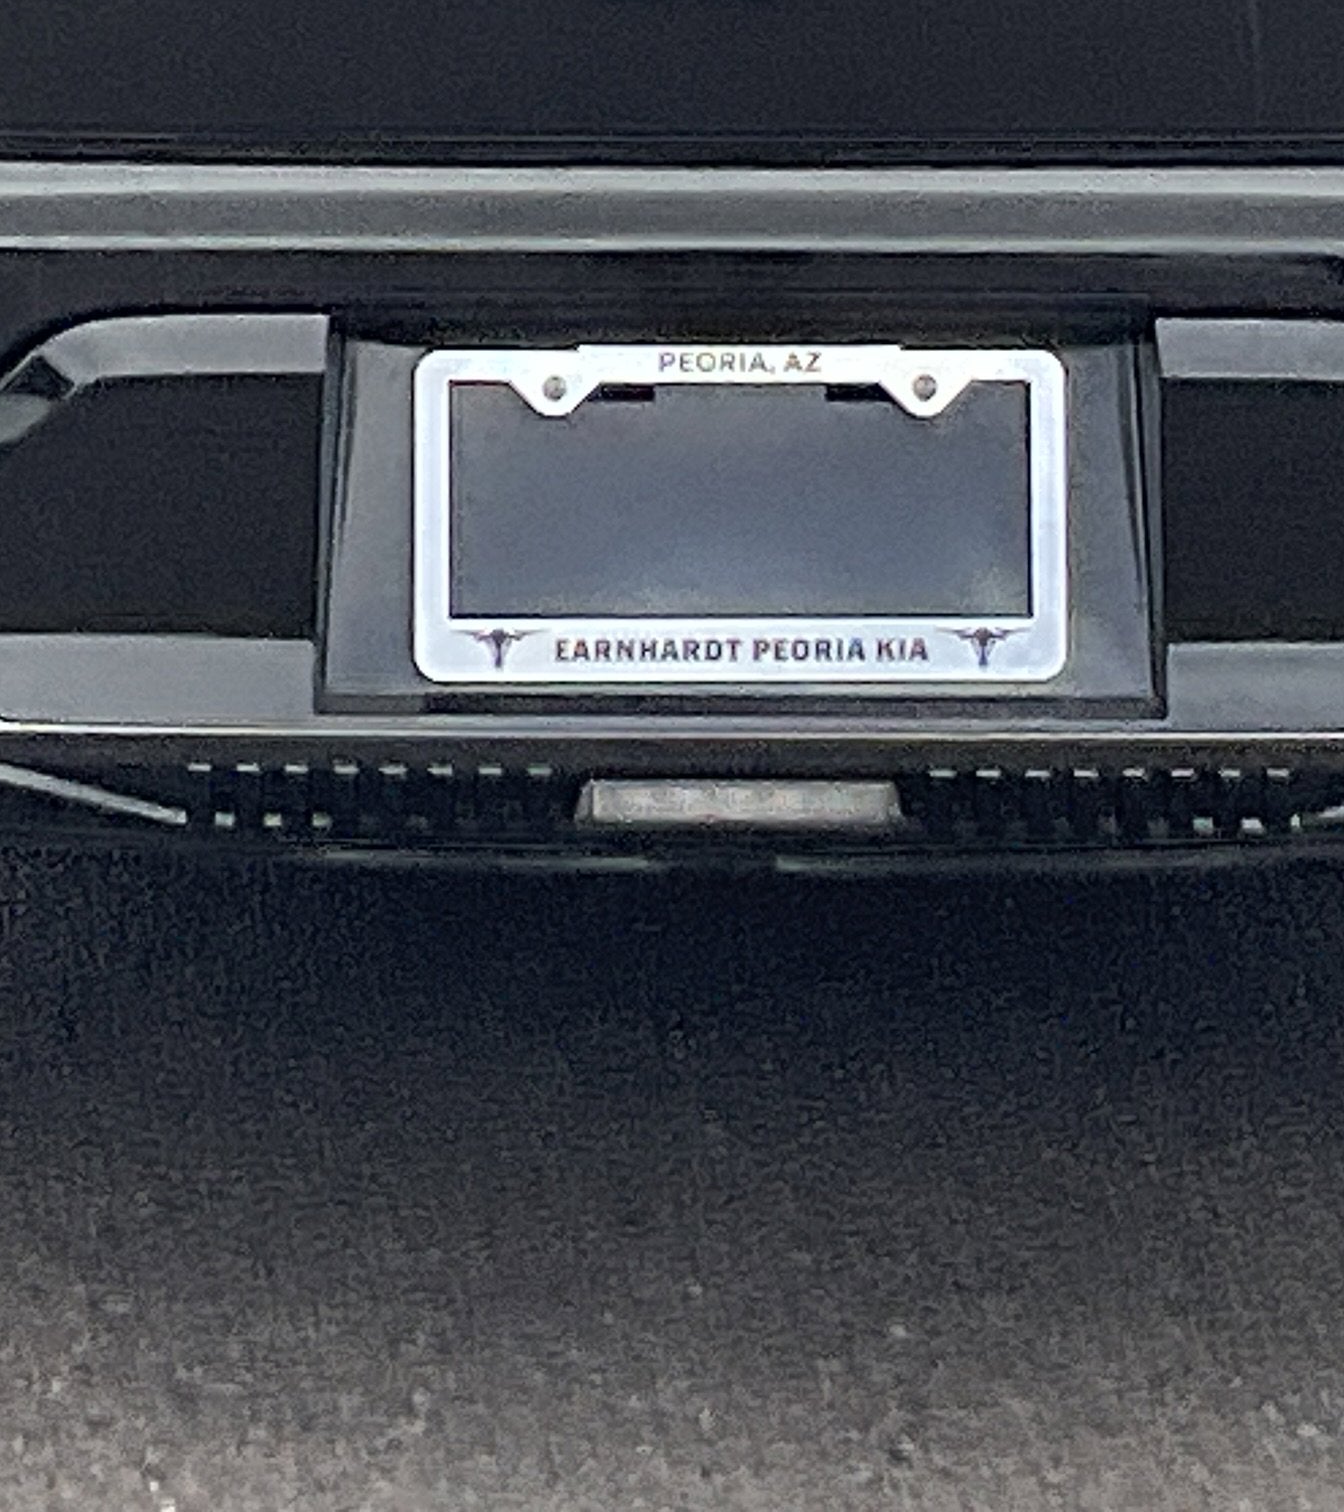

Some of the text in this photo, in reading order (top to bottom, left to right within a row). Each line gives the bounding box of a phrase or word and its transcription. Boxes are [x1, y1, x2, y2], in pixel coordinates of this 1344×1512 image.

[658, 352, 822, 374] PEORIA, AZ
[555, 639, 928, 662] EARNHARDT PEORIA KIA
